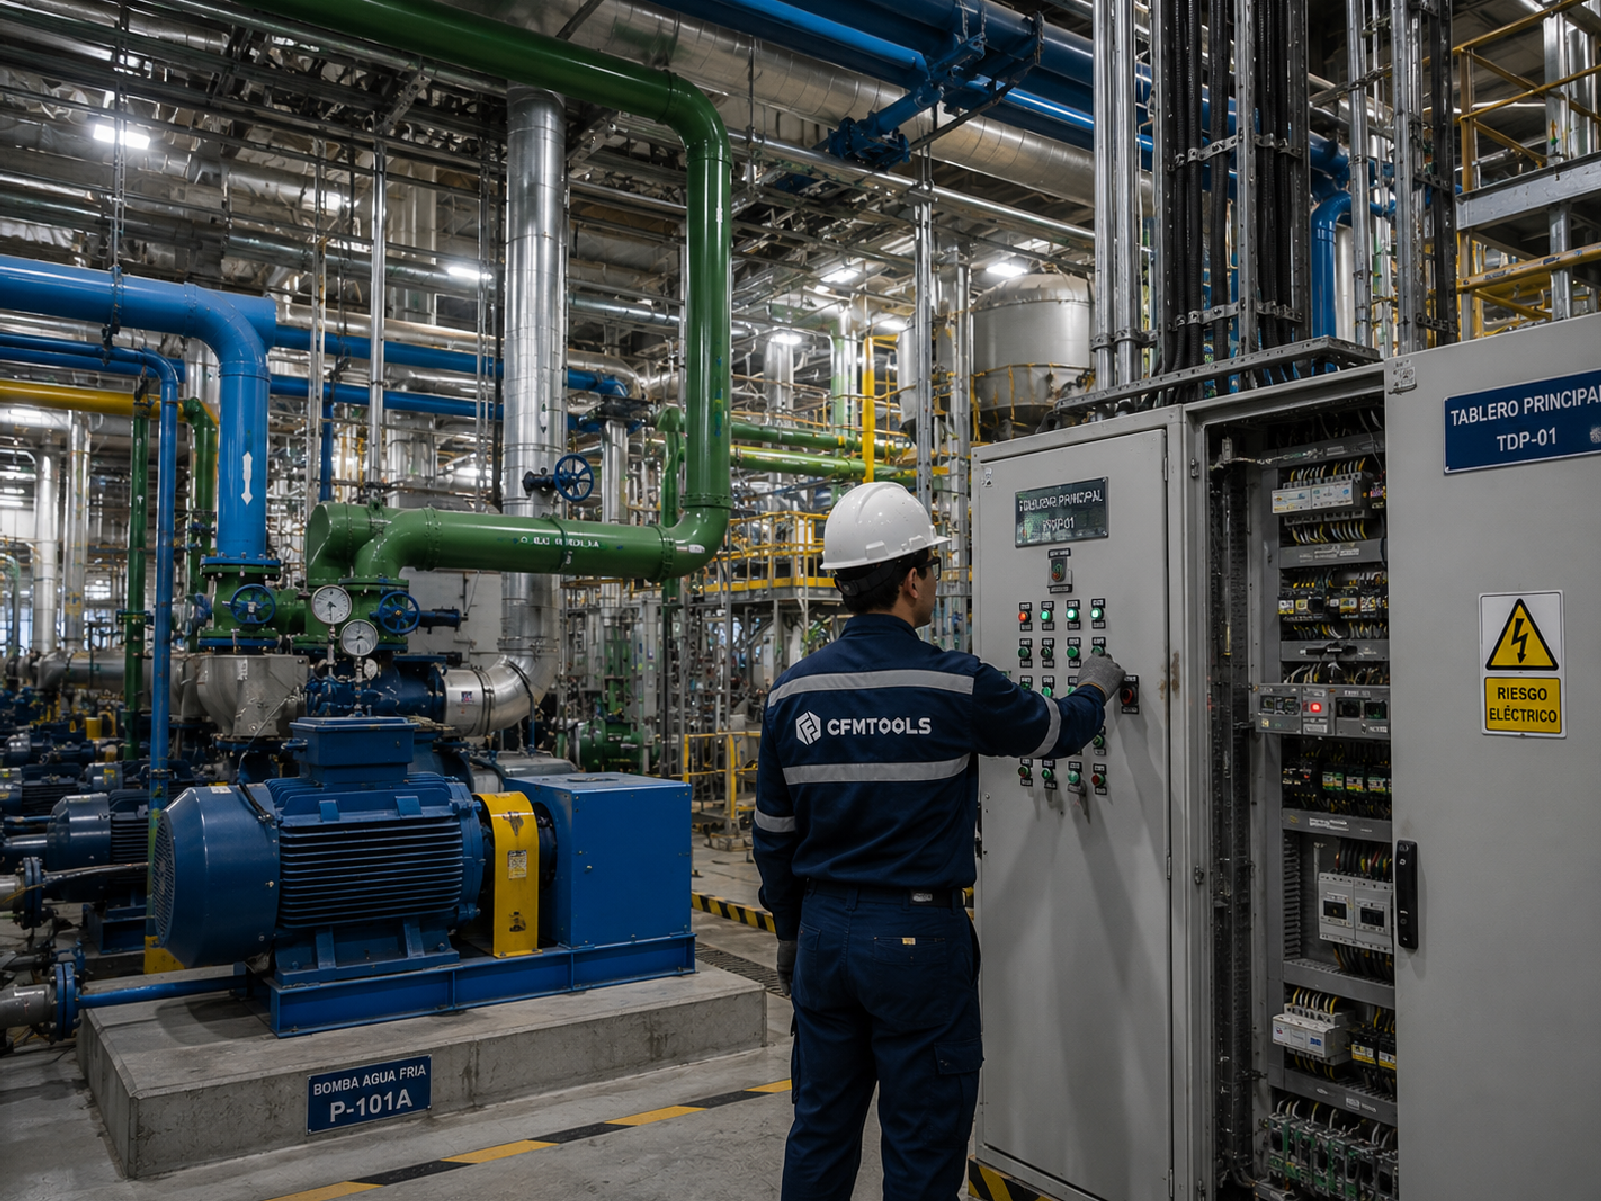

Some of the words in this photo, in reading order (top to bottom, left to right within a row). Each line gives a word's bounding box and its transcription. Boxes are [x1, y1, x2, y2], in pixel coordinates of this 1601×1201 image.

[1451, 400, 1519, 427] TABLERO
[1524, 384, 1601, 414] PRINCIPA
[1497, 427, 1556, 451] TDP-01
[1497, 687, 1547, 701] RIESGO
[1489, 705, 1557, 723] ELÉCTRICO
[827, 717, 932, 736] CFMTOOLS
[313, 1076, 359, 1096] BOMBA
[363, 1070, 397, 1087] AGUA
[400, 1064, 426, 1081] FRIA
[330, 1089, 412, 1122] P-101A
